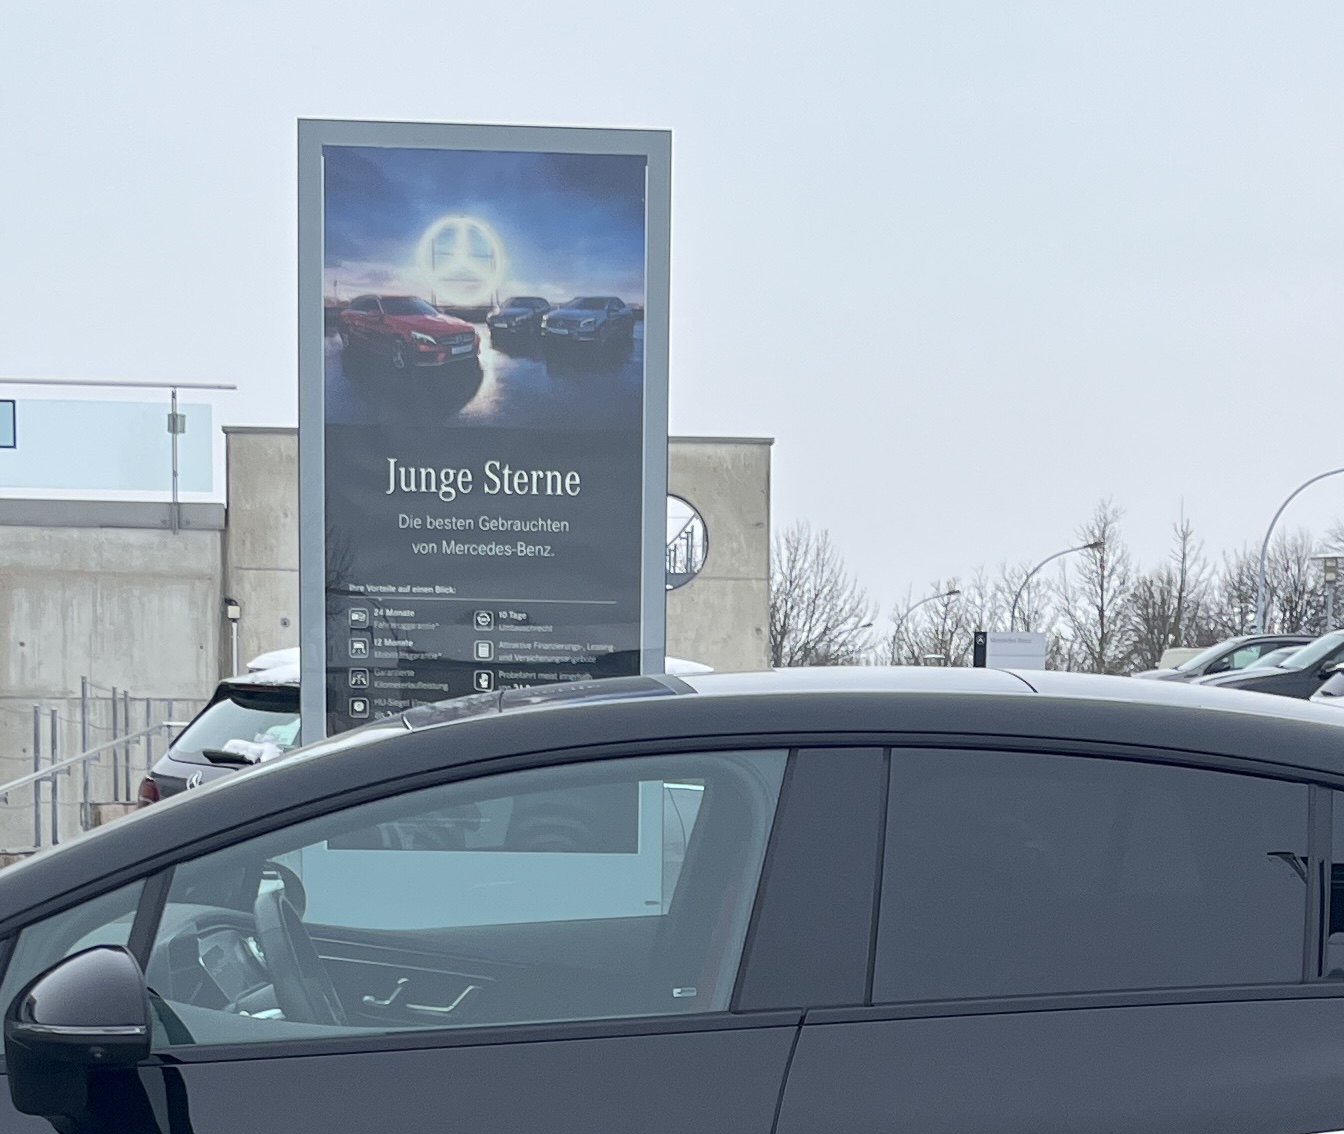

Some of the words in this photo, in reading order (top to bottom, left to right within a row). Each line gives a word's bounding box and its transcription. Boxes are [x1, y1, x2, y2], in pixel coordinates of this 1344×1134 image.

[386, 457, 473, 502] Junge
[484, 460, 581, 496] Sterne
[398, 513, 422, 529] Die
[426, 514, 474, 531] besten
[478, 515, 570, 532] Gebrauchten
[411, 542, 438, 555] von
[441, 540, 556, 557] Mercedes-Benz.
[509, 611, 528, 621] Tage
